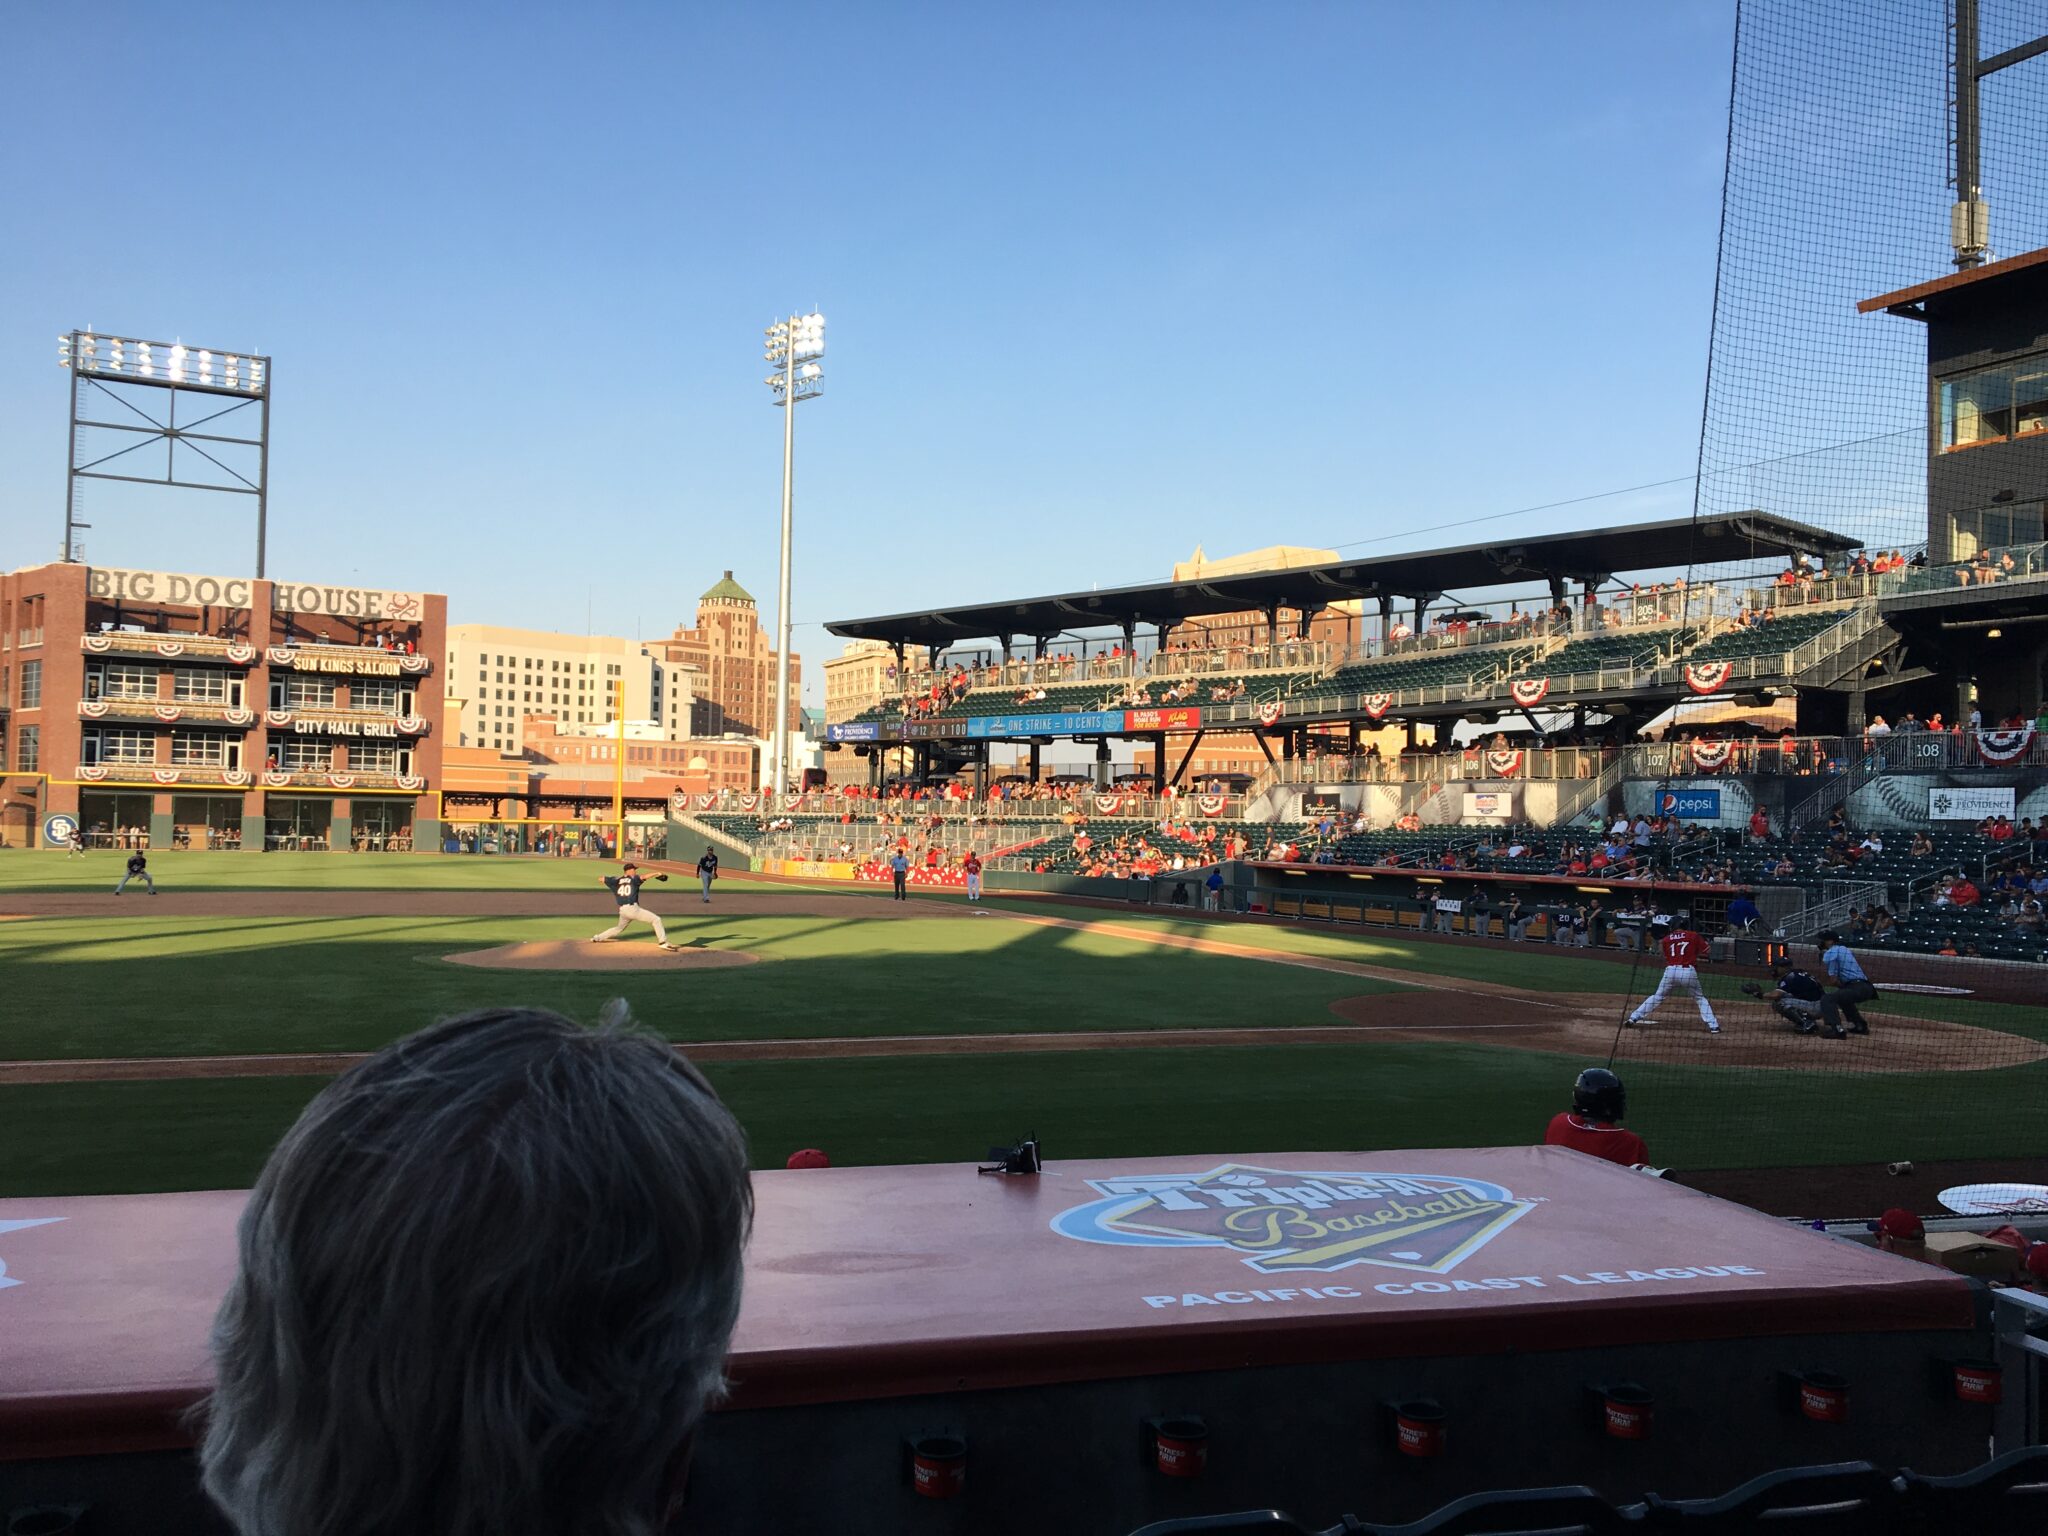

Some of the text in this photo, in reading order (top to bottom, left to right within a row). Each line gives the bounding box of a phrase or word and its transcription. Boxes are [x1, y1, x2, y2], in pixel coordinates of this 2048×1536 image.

[91, 569, 383, 618] BIG DOG HOUSE
[1637, 604, 1654, 616] 205
[293, 657, 400, 676] SUN KINGS SALOON
[1168, 711, 1189, 723] KLAQ
[295, 719, 398, 738] CITY HALL GRILL
[1008, 719, 1023, 732] ONE
[1025, 718, 1052, 731] STRIKE
[1064, 718, 1073, 729] 10
[1075, 716, 1101, 728] CENTS
[1916, 744, 1940, 757] 108
[1465, 760, 1479, 770] 106
[1647, 755, 1664, 766] 107
[1303, 765, 1314, 775] 105
[1679, 797, 1713, 812] pepsi
[1956, 800, 2010, 809] PROVIDENCE
[565, 831, 579, 839] 322
[617, 884, 632, 897] 40
[1559, 914, 1570, 922] 20
[1670, 941, 1689, 957] 17
[1224, 1191, 1504, 1248] Baseball
[1142, 1265, 1767, 1309] PACIFIC COAST LEAGUE
[1963, 1381, 1984, 1390] FIRM
[1807, 1398, 1827, 1410] FIRM
[1610, 1417, 1631, 1426] FIRM
[1400, 1433, 1419, 1444] FIRM
